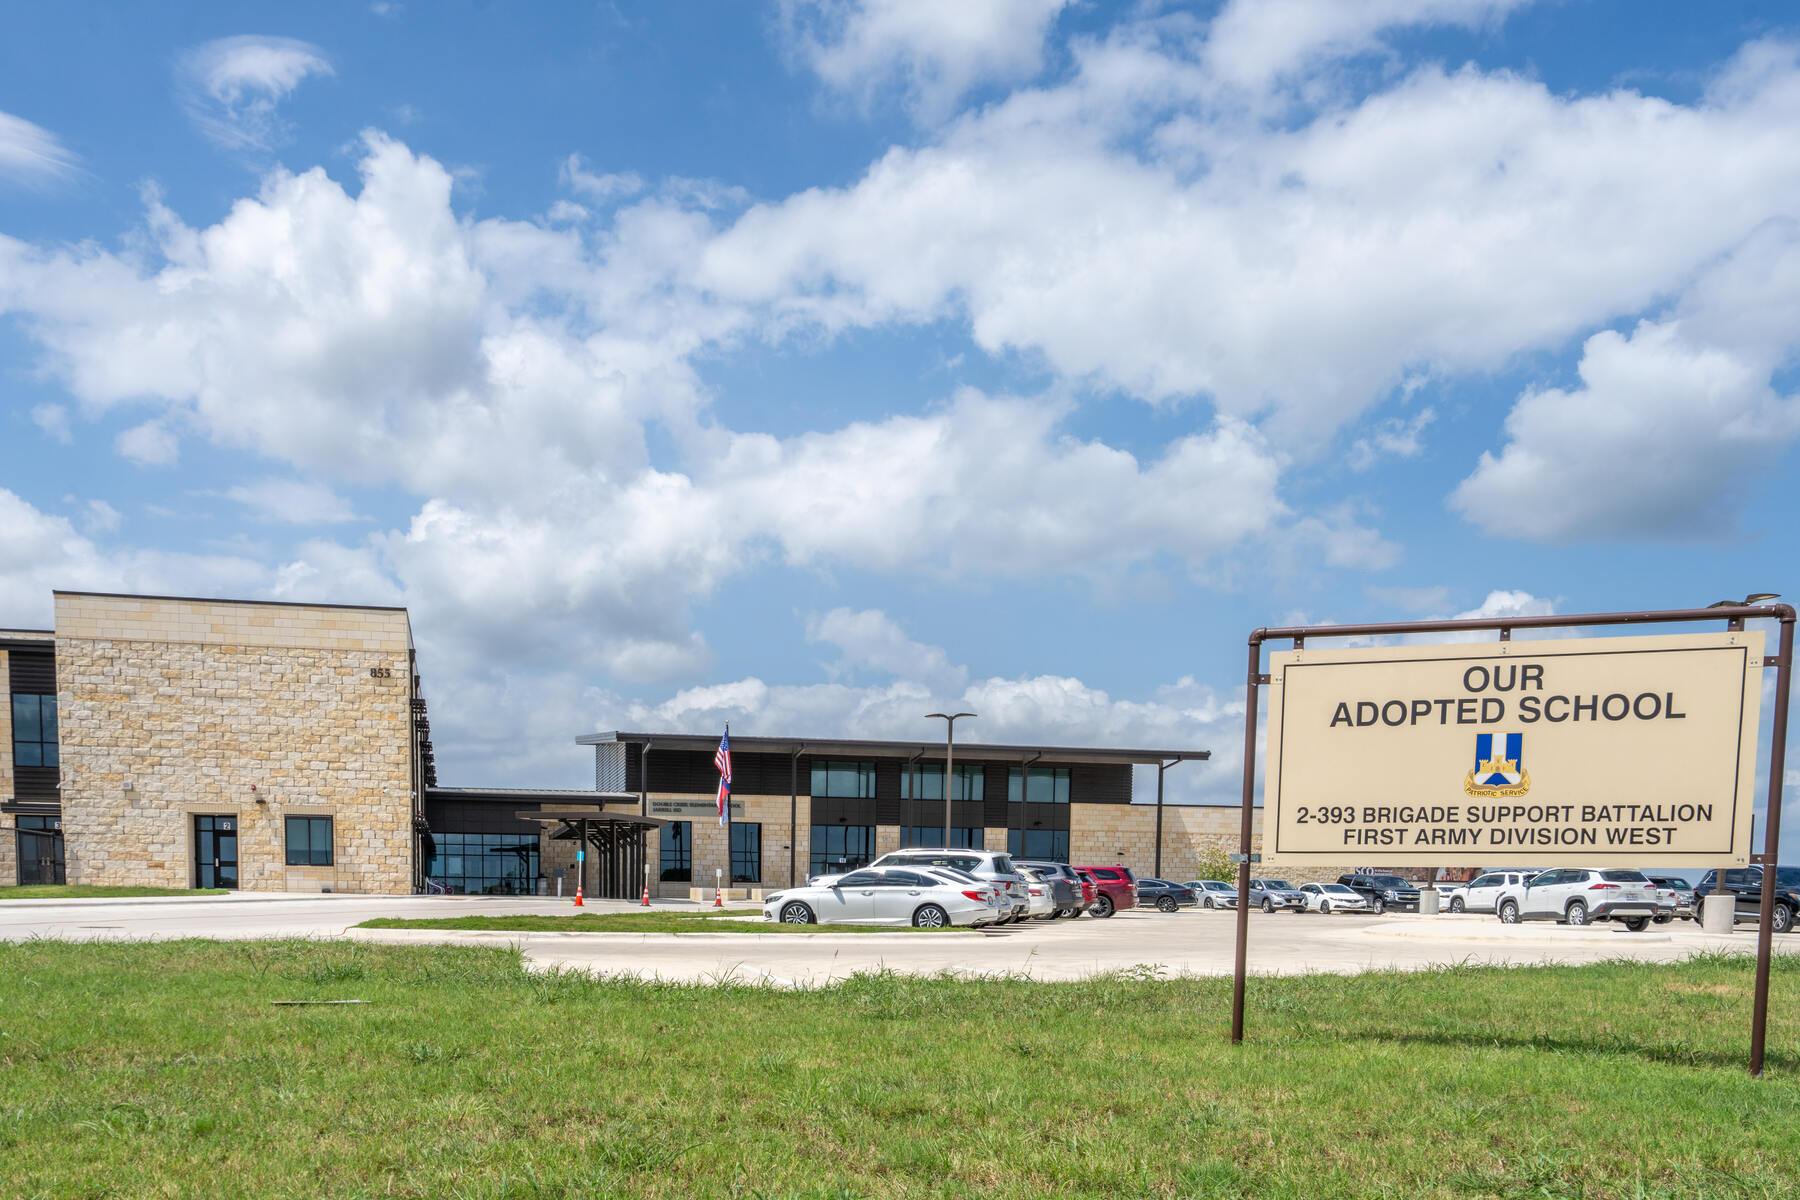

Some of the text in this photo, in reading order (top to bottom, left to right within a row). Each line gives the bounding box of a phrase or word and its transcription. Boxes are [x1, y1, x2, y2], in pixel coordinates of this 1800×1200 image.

[370, 668, 391, 679] 855
[1463, 664, 1545, 693] OUR
[1329, 692, 1687, 728] ADOPTED SCHOOL
[1466, 785, 1529, 797] PATRIOTIC SERVICE
[1296, 803, 1713, 825] 2-393 BRIGADE SUPPORT BATTALION
[1343, 827, 1678, 846] FIRST ARMY DIVISION WEST
